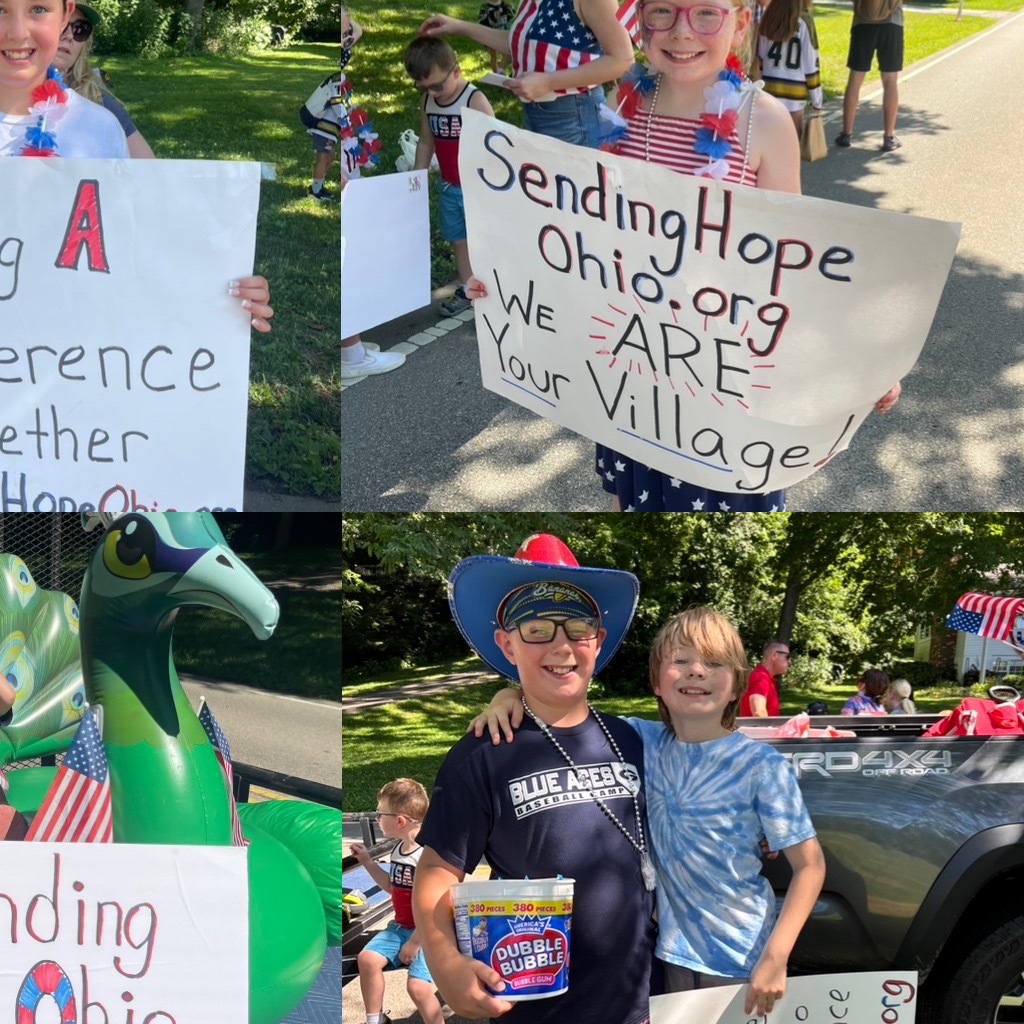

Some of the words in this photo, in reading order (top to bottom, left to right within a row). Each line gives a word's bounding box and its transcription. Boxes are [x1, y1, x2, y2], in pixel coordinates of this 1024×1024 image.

[768, 37, 801, 70] 40
[429, 115, 461, 137] USA
[54, 178, 111, 274] A
[538, 224, 791, 357] Ohio.org
[493, 268, 557, 333] WE
[612, 313, 750, 398] ARE
[483, 313, 571, 401] Your
[862, 768, 900, 777] OFF
[901, 767, 949, 776] ROAD
[509, 772, 563, 806] BLUE
[567, 766, 616, 791] ACES
[517, 792, 584, 815] BASEBALL
[470, 904, 485, 913] 380
[513, 903, 534, 912] 380
[562, 903, 572, 912] 38
[513, 921, 545, 930] AMERICA'S
[496, 938, 562, 961] DUBBLE
[500, 951, 564, 976] BUBBLE
[513, 977, 537, 987] BUBBLE
[537, 975, 552, 983] GUM
